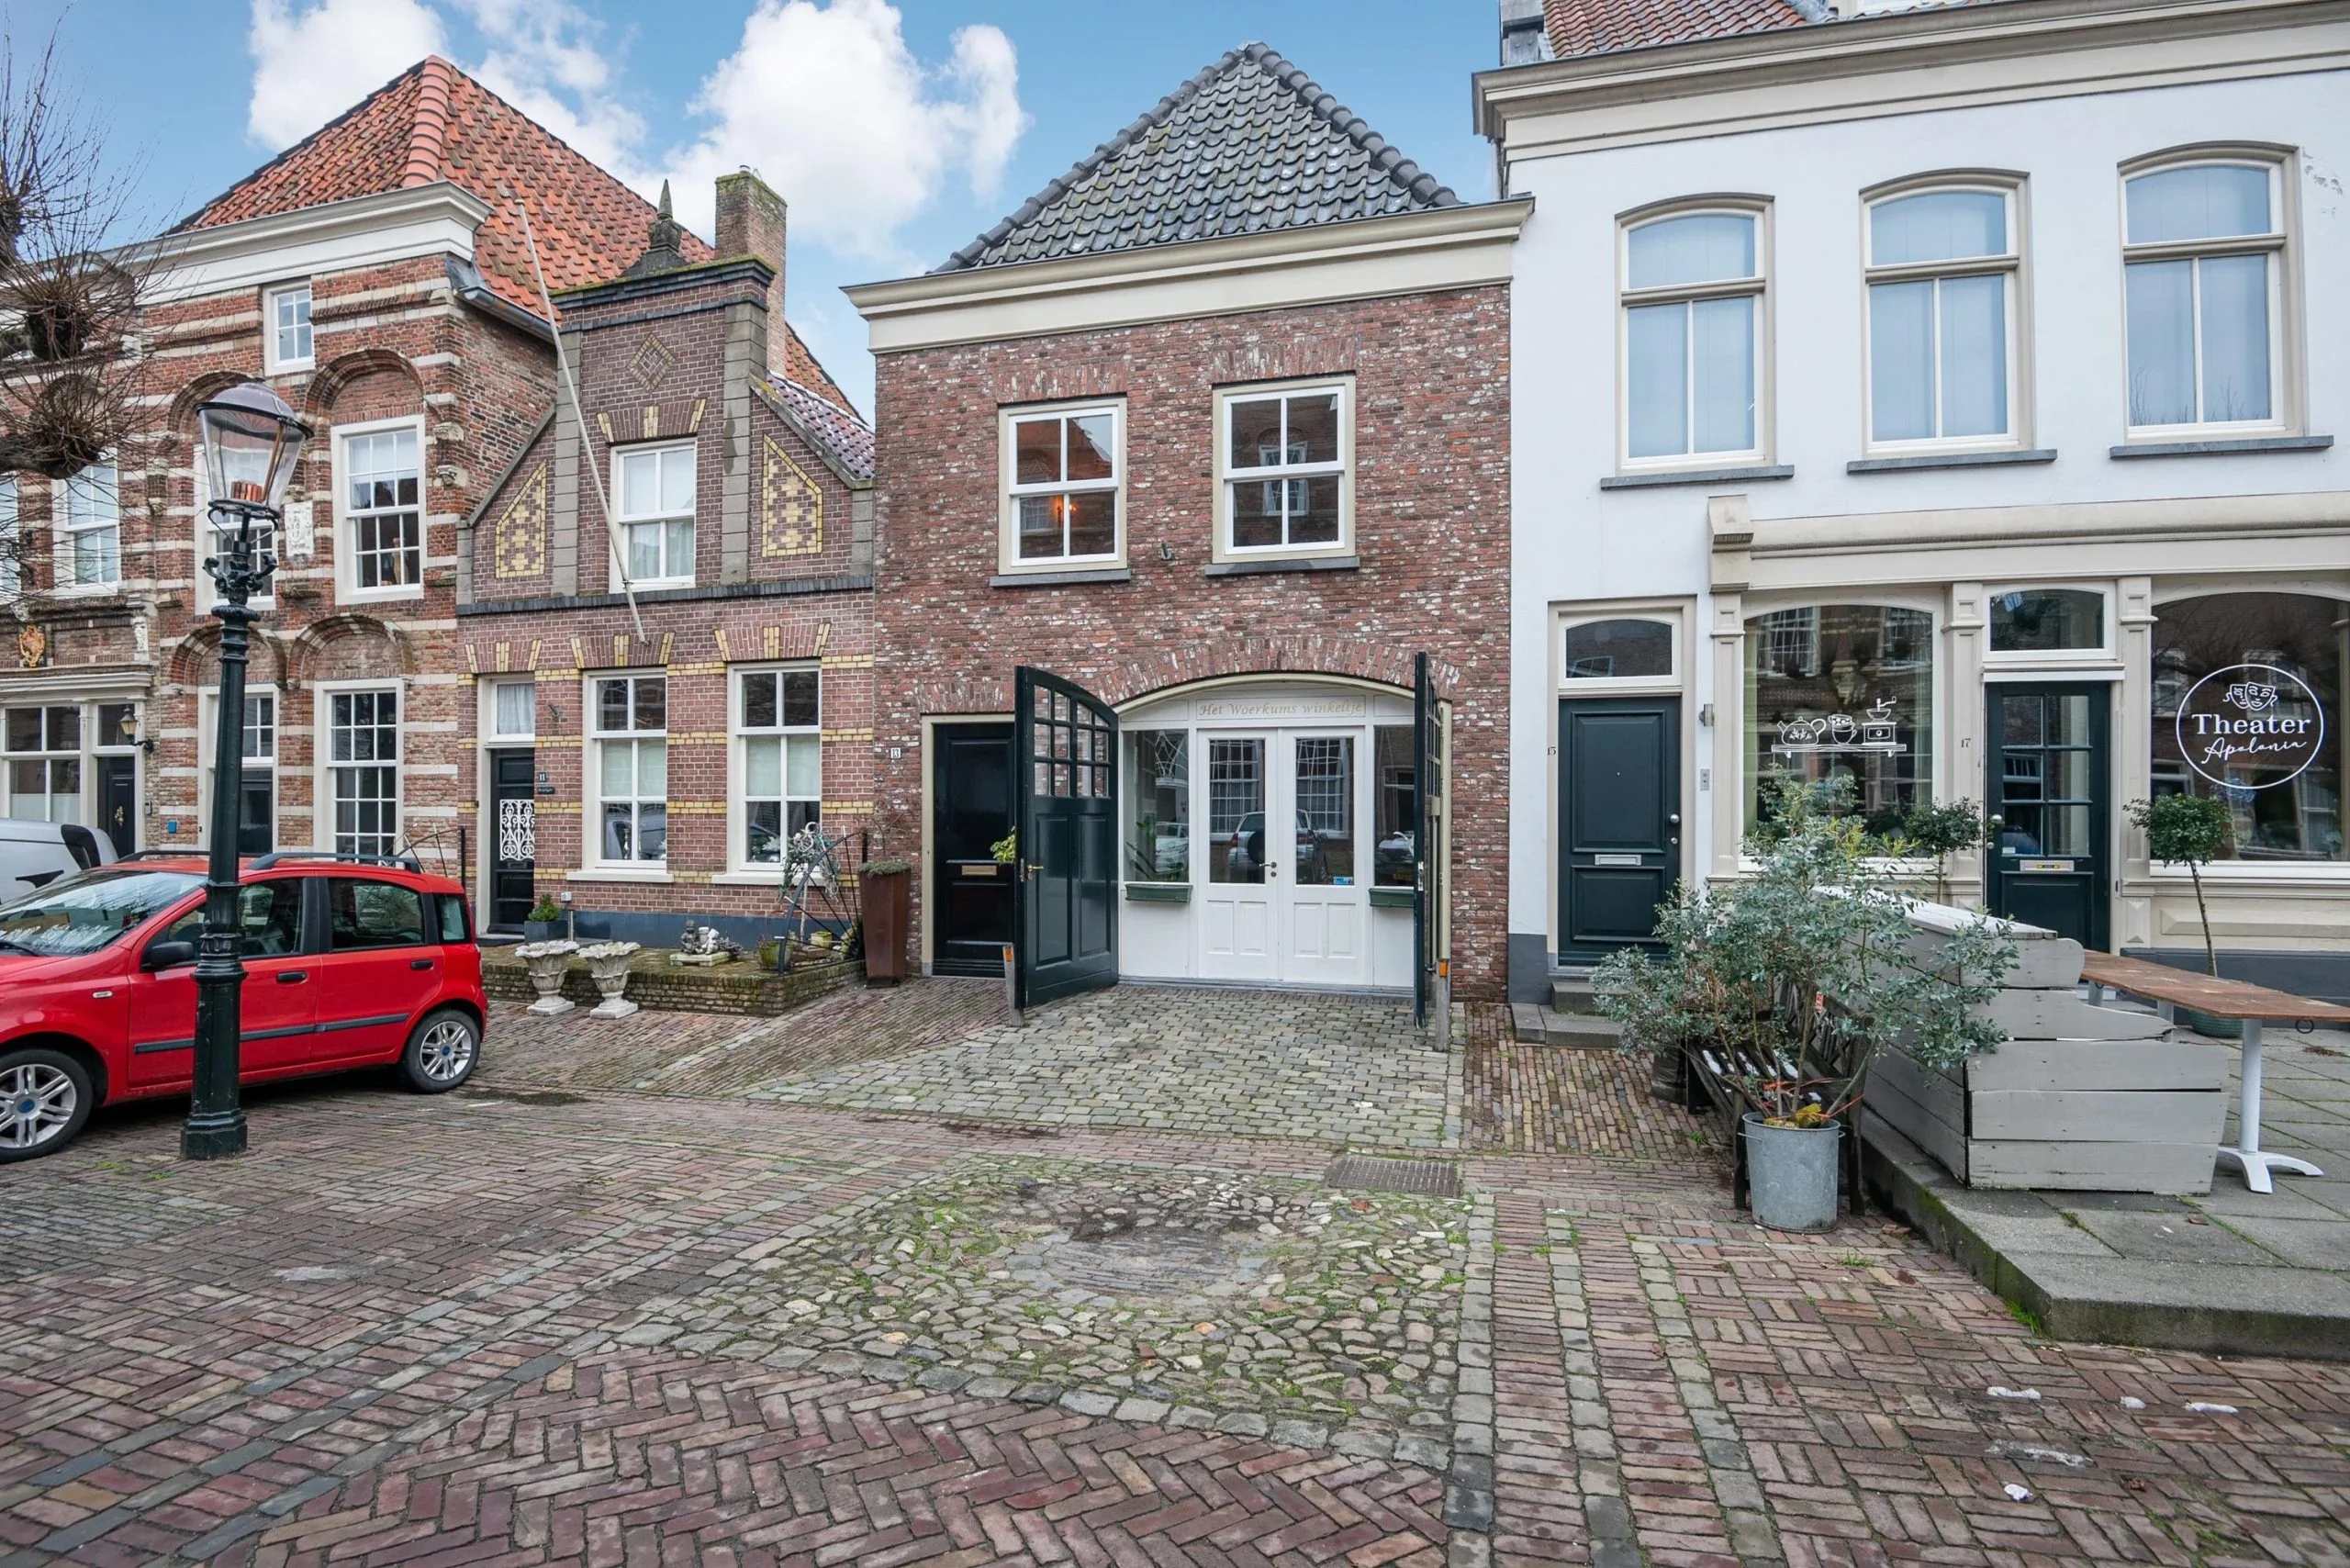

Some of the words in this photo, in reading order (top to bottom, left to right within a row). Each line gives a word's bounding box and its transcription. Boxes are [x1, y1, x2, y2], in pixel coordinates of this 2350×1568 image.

[1199, 703, 1224, 716] Het
[1228, 702, 1297, 715] Woerkums
[1303, 700, 1362, 715] winkeltje
[2191, 713, 2311, 735] Theater
[1961, 738, 1972, 748] 17
[891, 748, 900, 758] 13
[1547, 745, 1557, 756] 15
[2200, 736, 2308, 765] Apolonia
